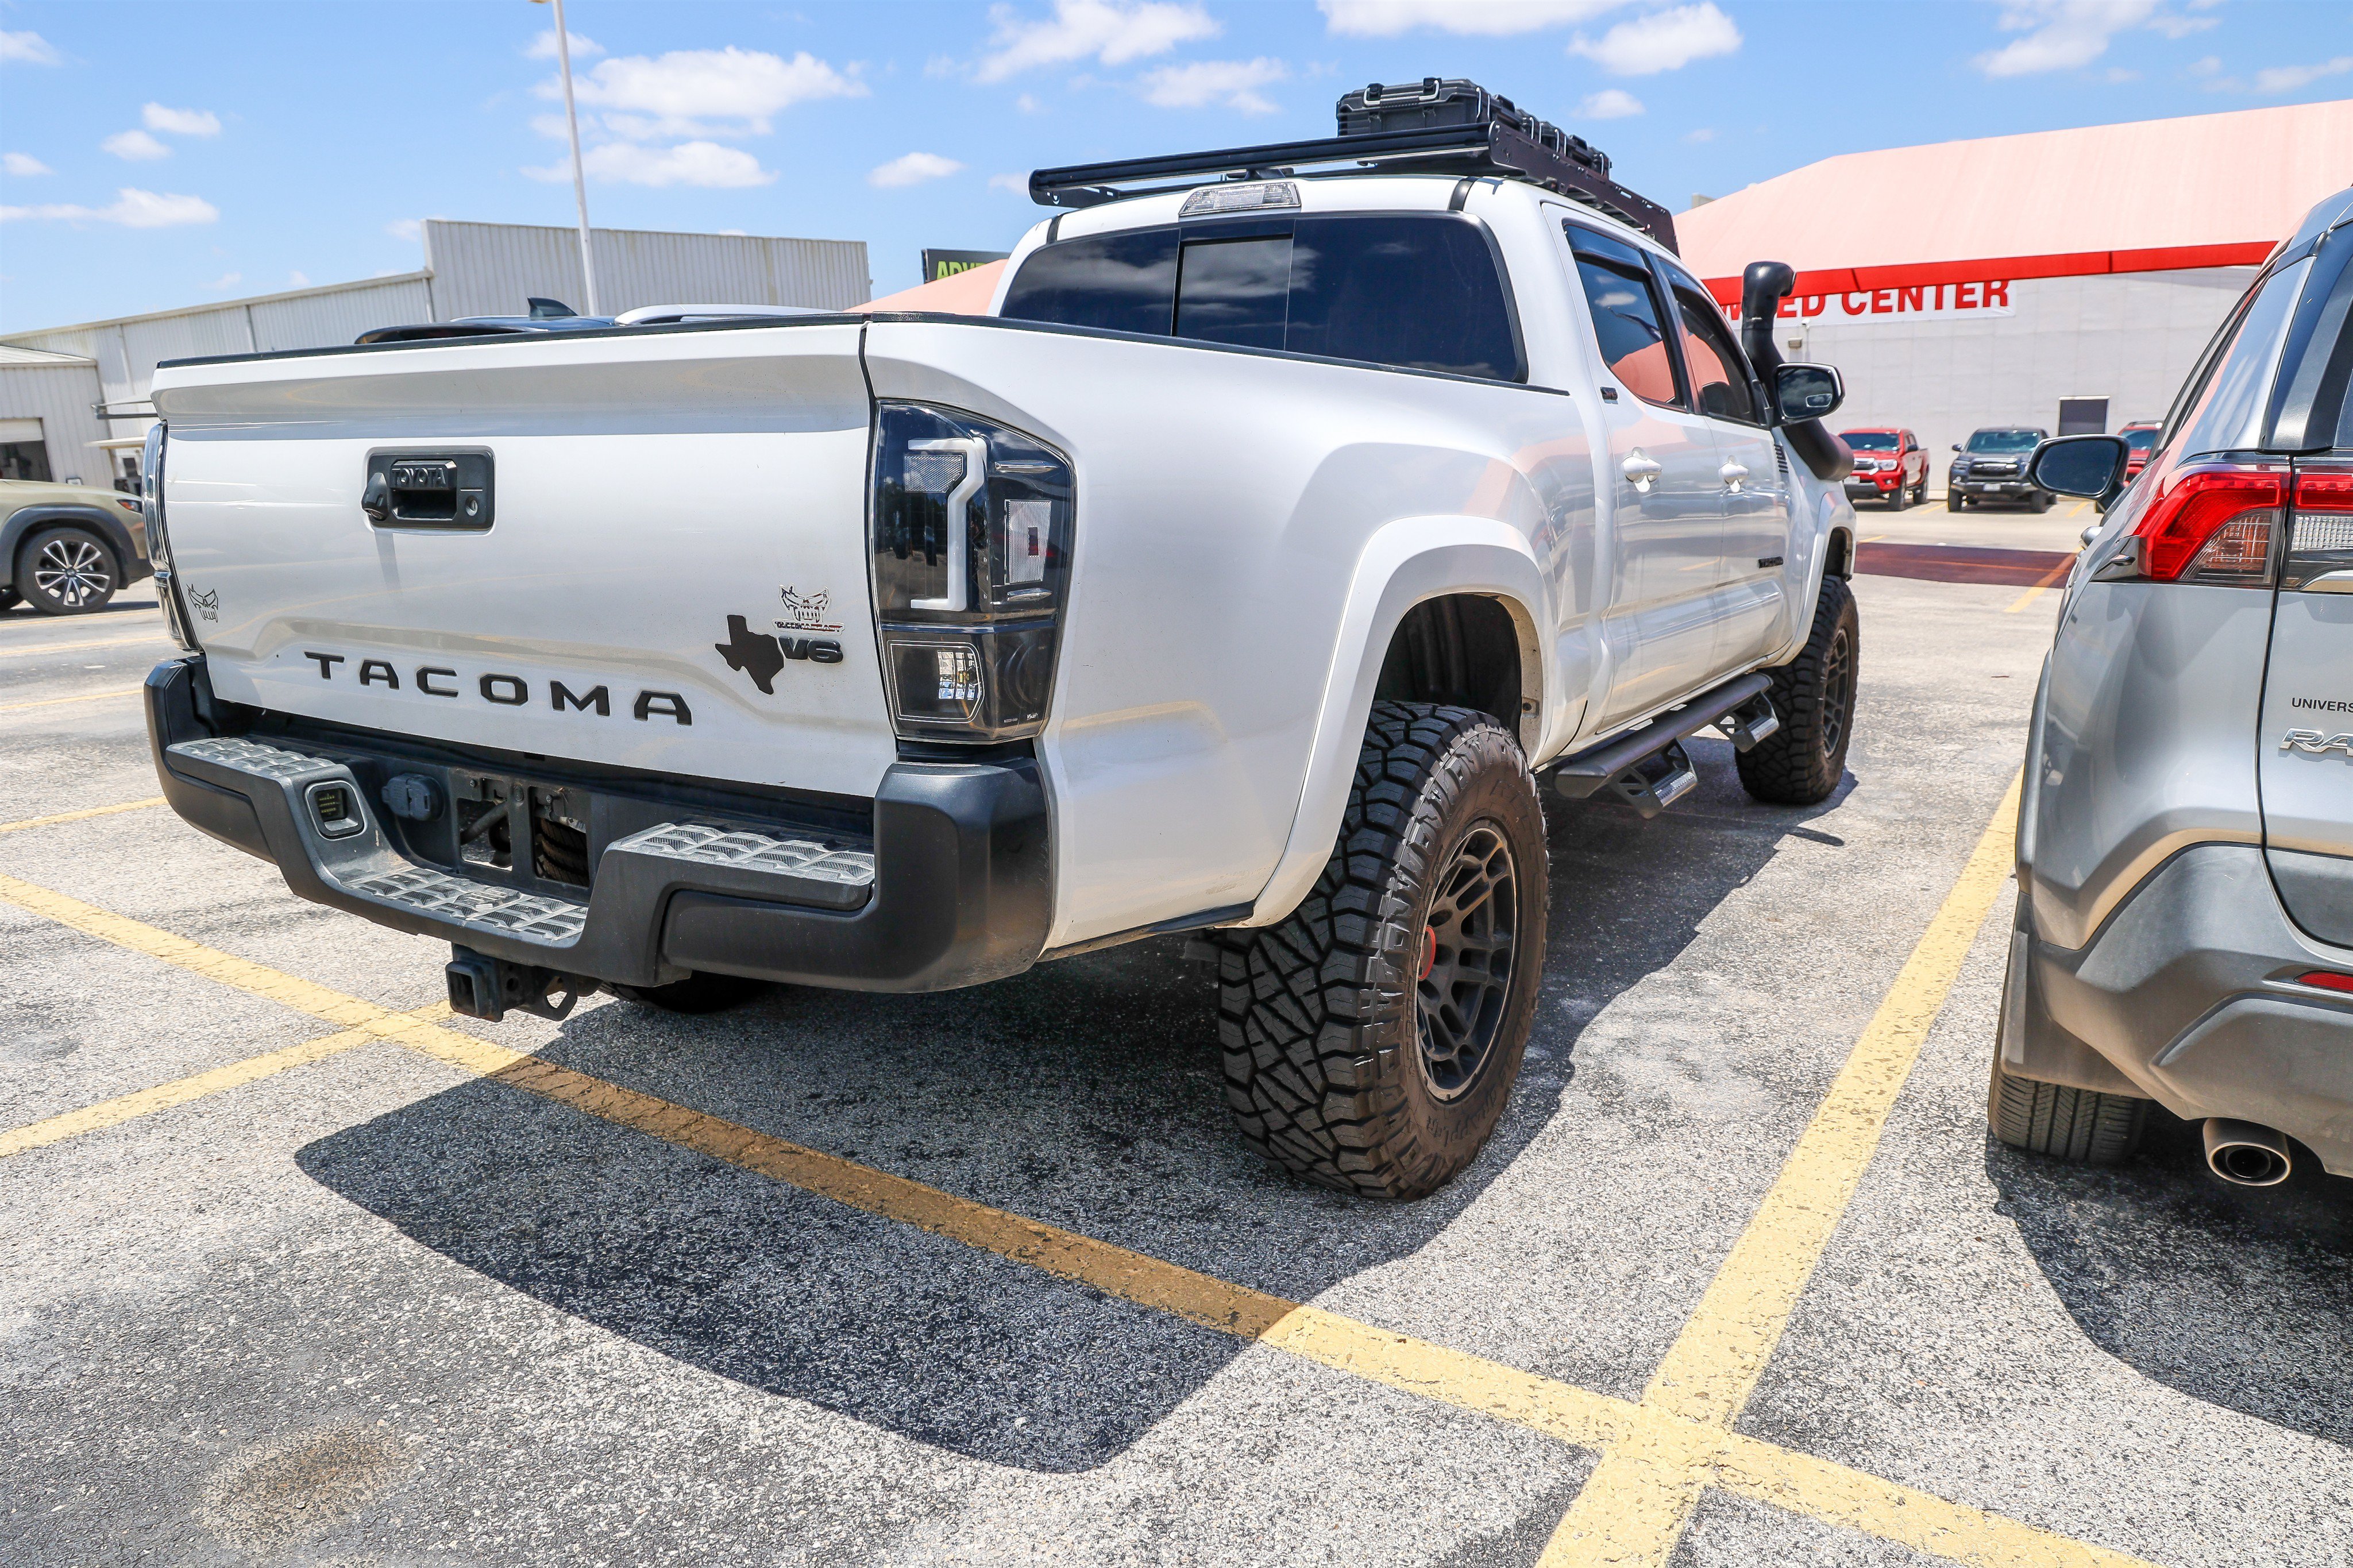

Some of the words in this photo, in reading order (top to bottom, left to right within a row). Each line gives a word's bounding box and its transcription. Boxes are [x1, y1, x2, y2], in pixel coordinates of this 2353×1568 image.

[1841, 280, 2009, 316] CENTER
[391, 468, 446, 488] TOYOTA
[778, 635, 844, 663] V6
[304, 651, 693, 726] TACOMA
